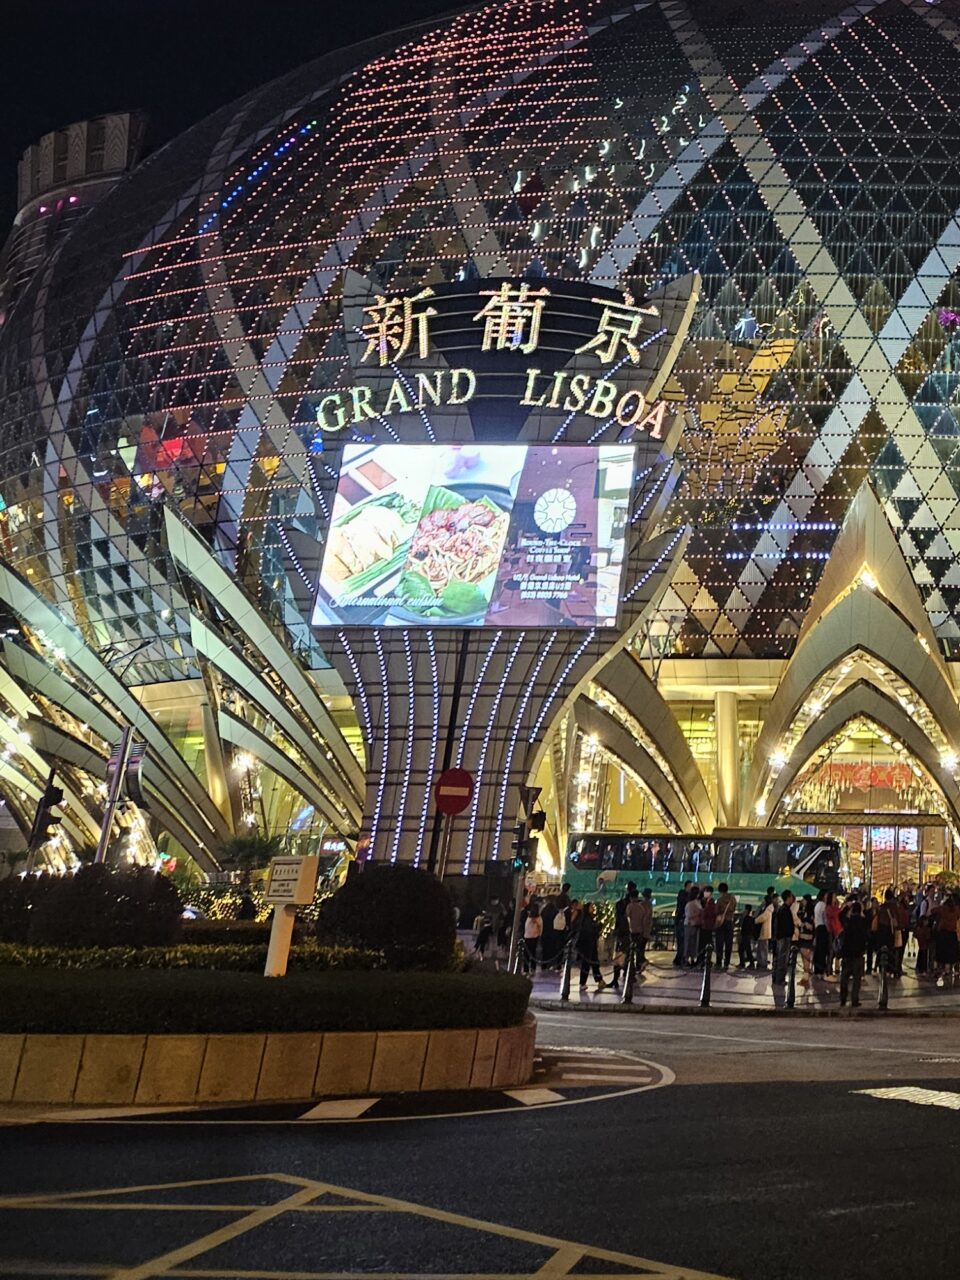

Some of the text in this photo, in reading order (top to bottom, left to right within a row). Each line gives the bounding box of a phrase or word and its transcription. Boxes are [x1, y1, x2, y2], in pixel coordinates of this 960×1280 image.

[361, 282, 661, 368] 新葡京
[317, 368, 668, 439] GRAND LISBOA
